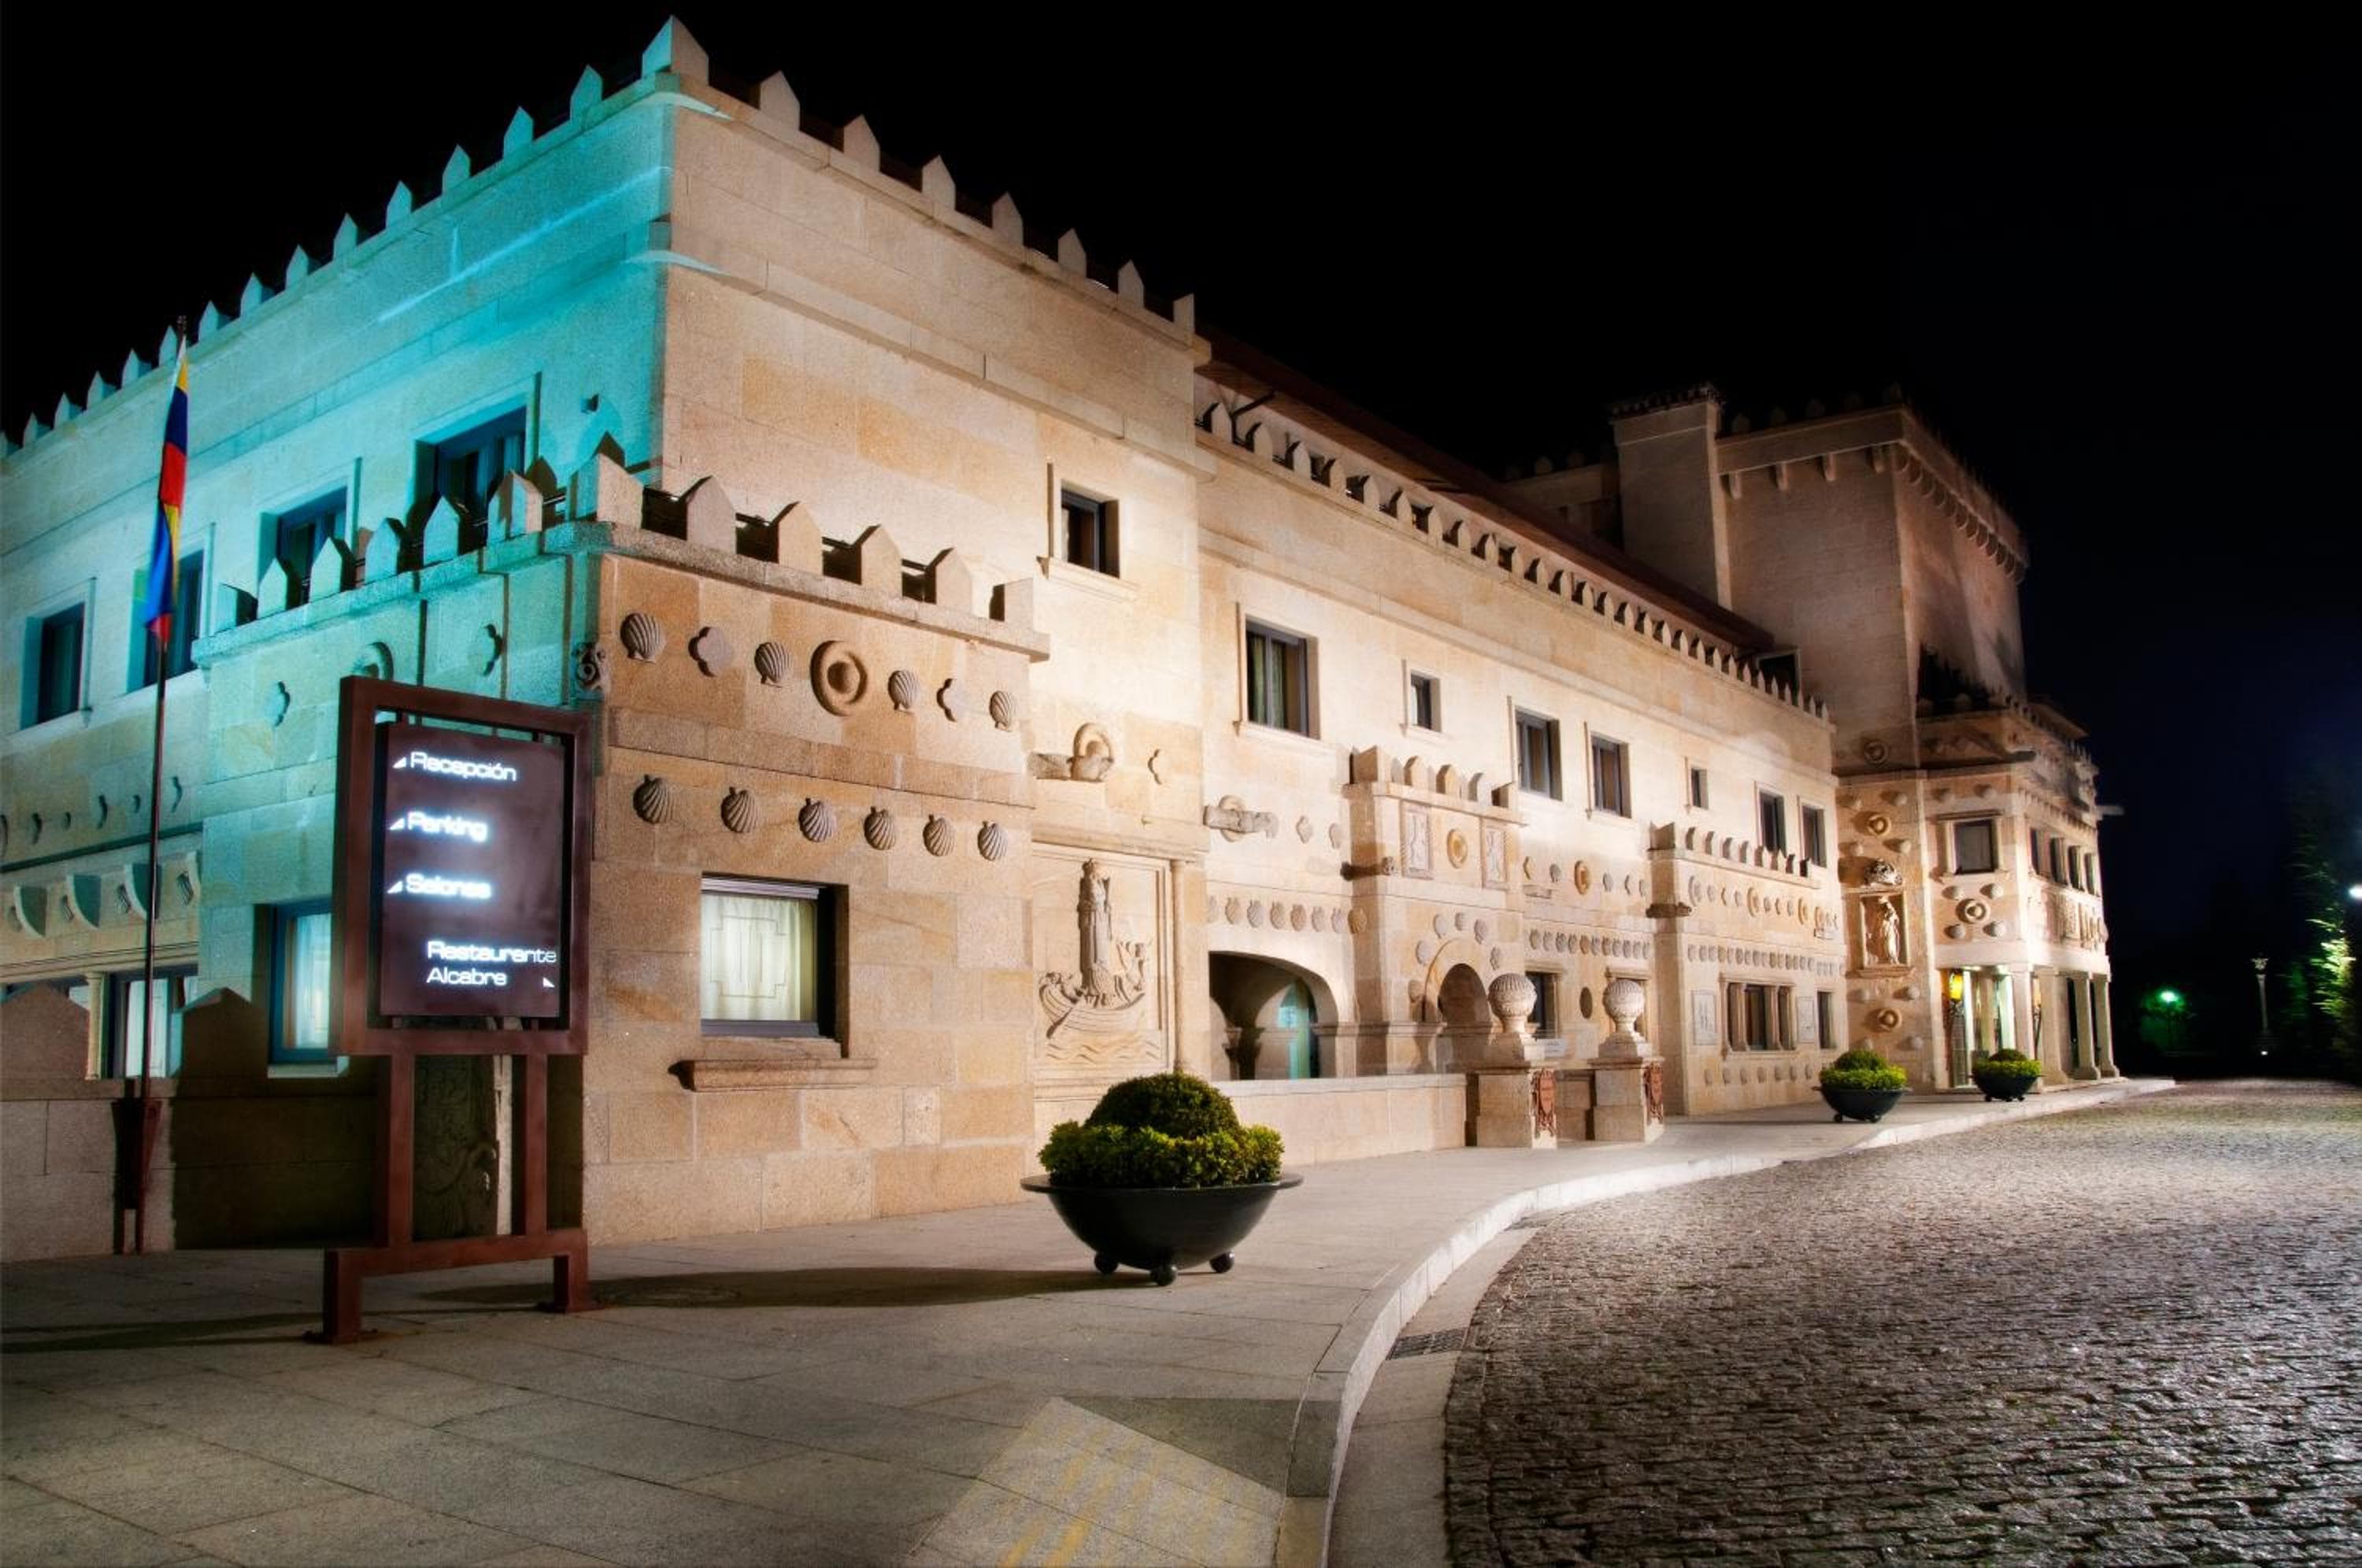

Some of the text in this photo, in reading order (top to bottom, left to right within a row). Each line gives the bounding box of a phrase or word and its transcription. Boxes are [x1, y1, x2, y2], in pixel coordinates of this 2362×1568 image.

[409, 751, 517, 782] Recepción
[407, 811, 489, 845] Parking
[405, 873, 493, 900] Salones
[427, 940, 557, 963] Restaurante
[426, 967, 508, 986] Alcabre
